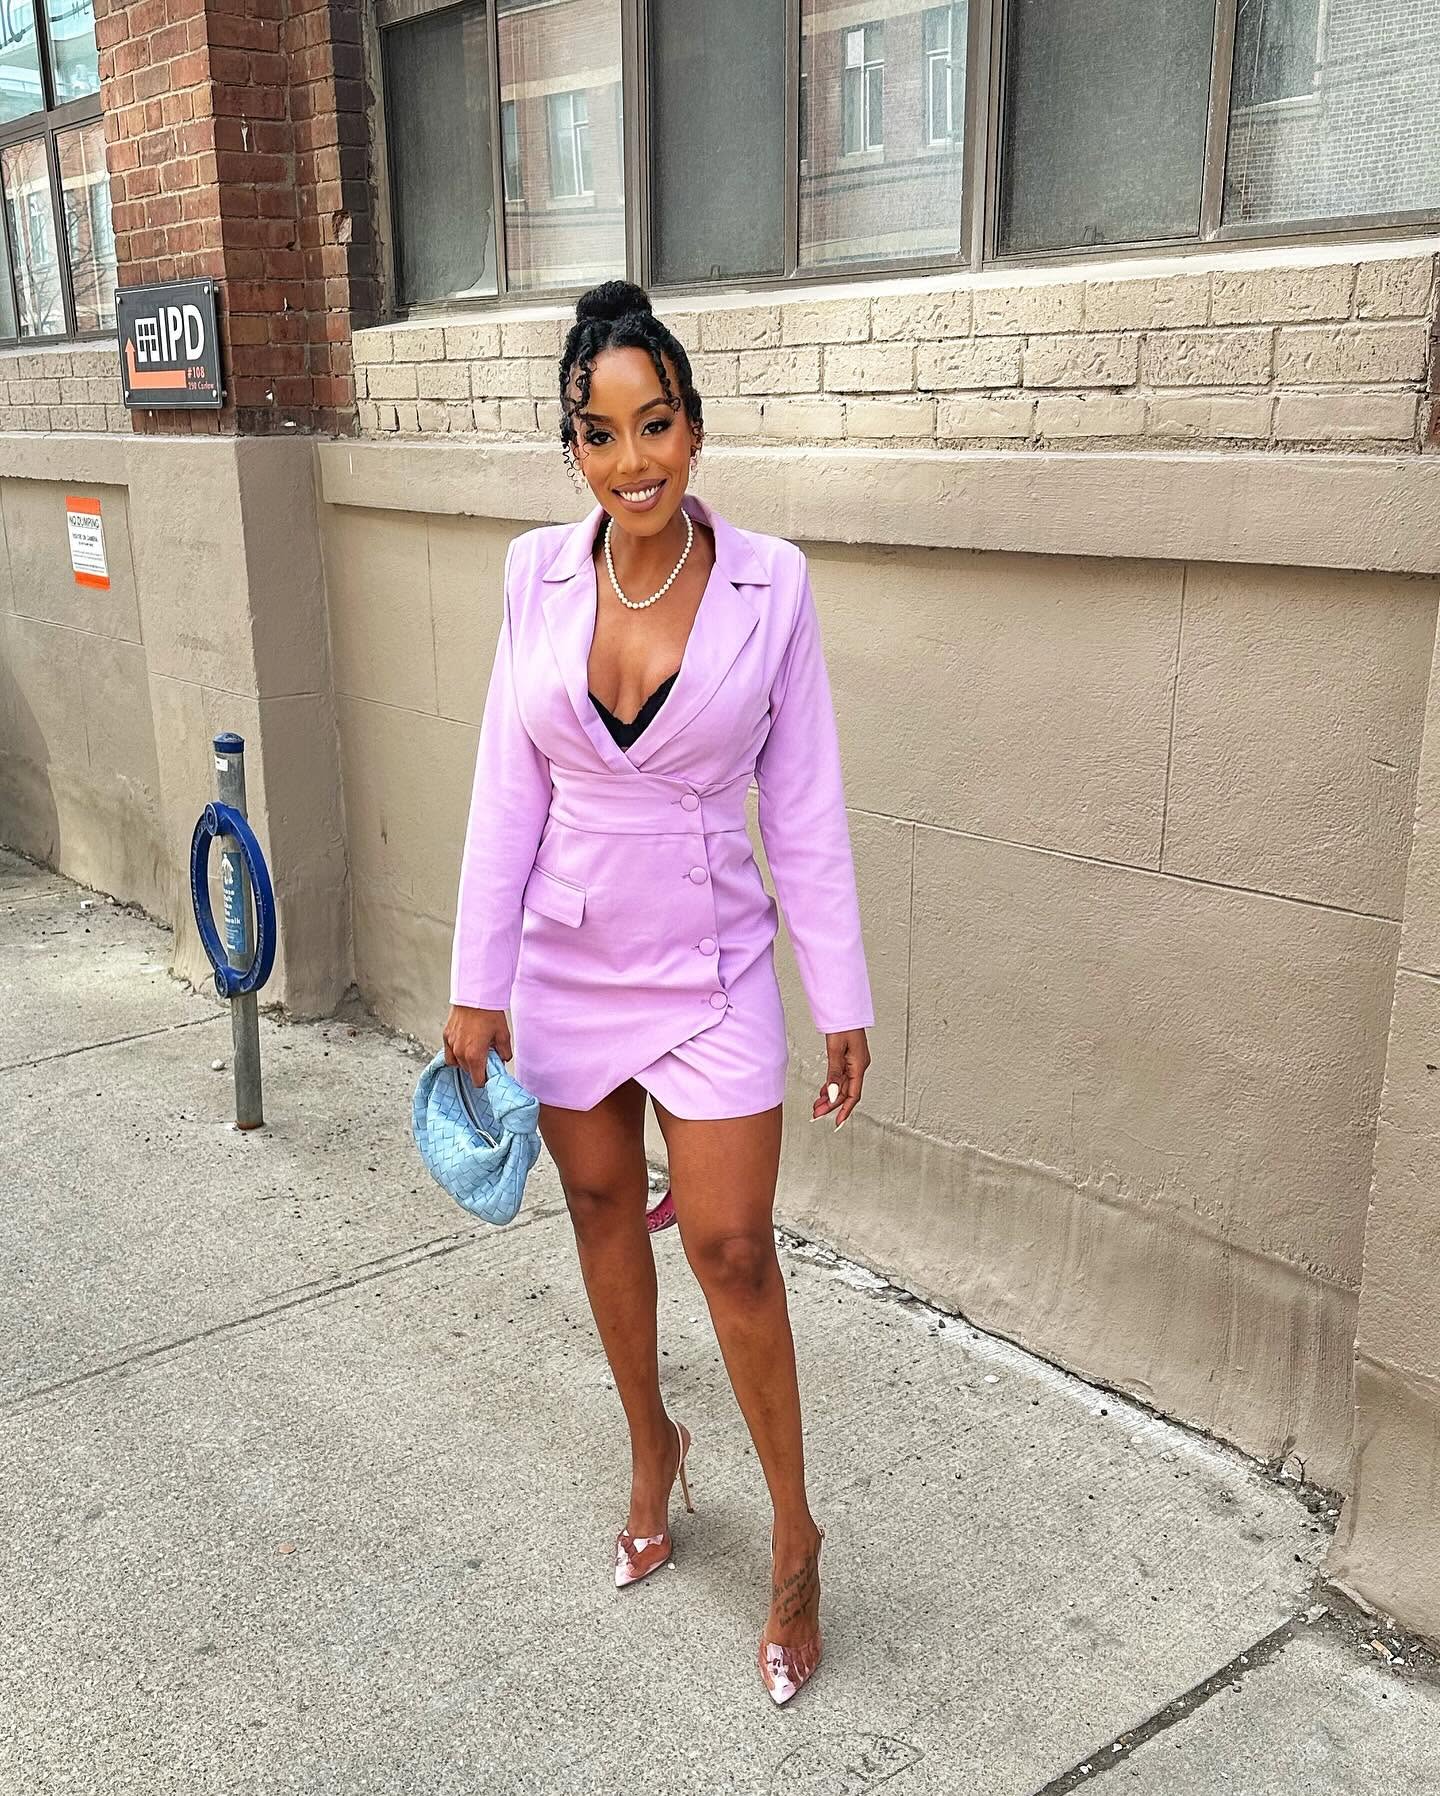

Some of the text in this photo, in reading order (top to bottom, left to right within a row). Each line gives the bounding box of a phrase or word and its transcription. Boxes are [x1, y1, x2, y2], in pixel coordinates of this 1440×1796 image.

[159, 304, 204, 361] IPD
[187, 366, 205, 379] #108
[77, 516, 99, 528] DUMPING
